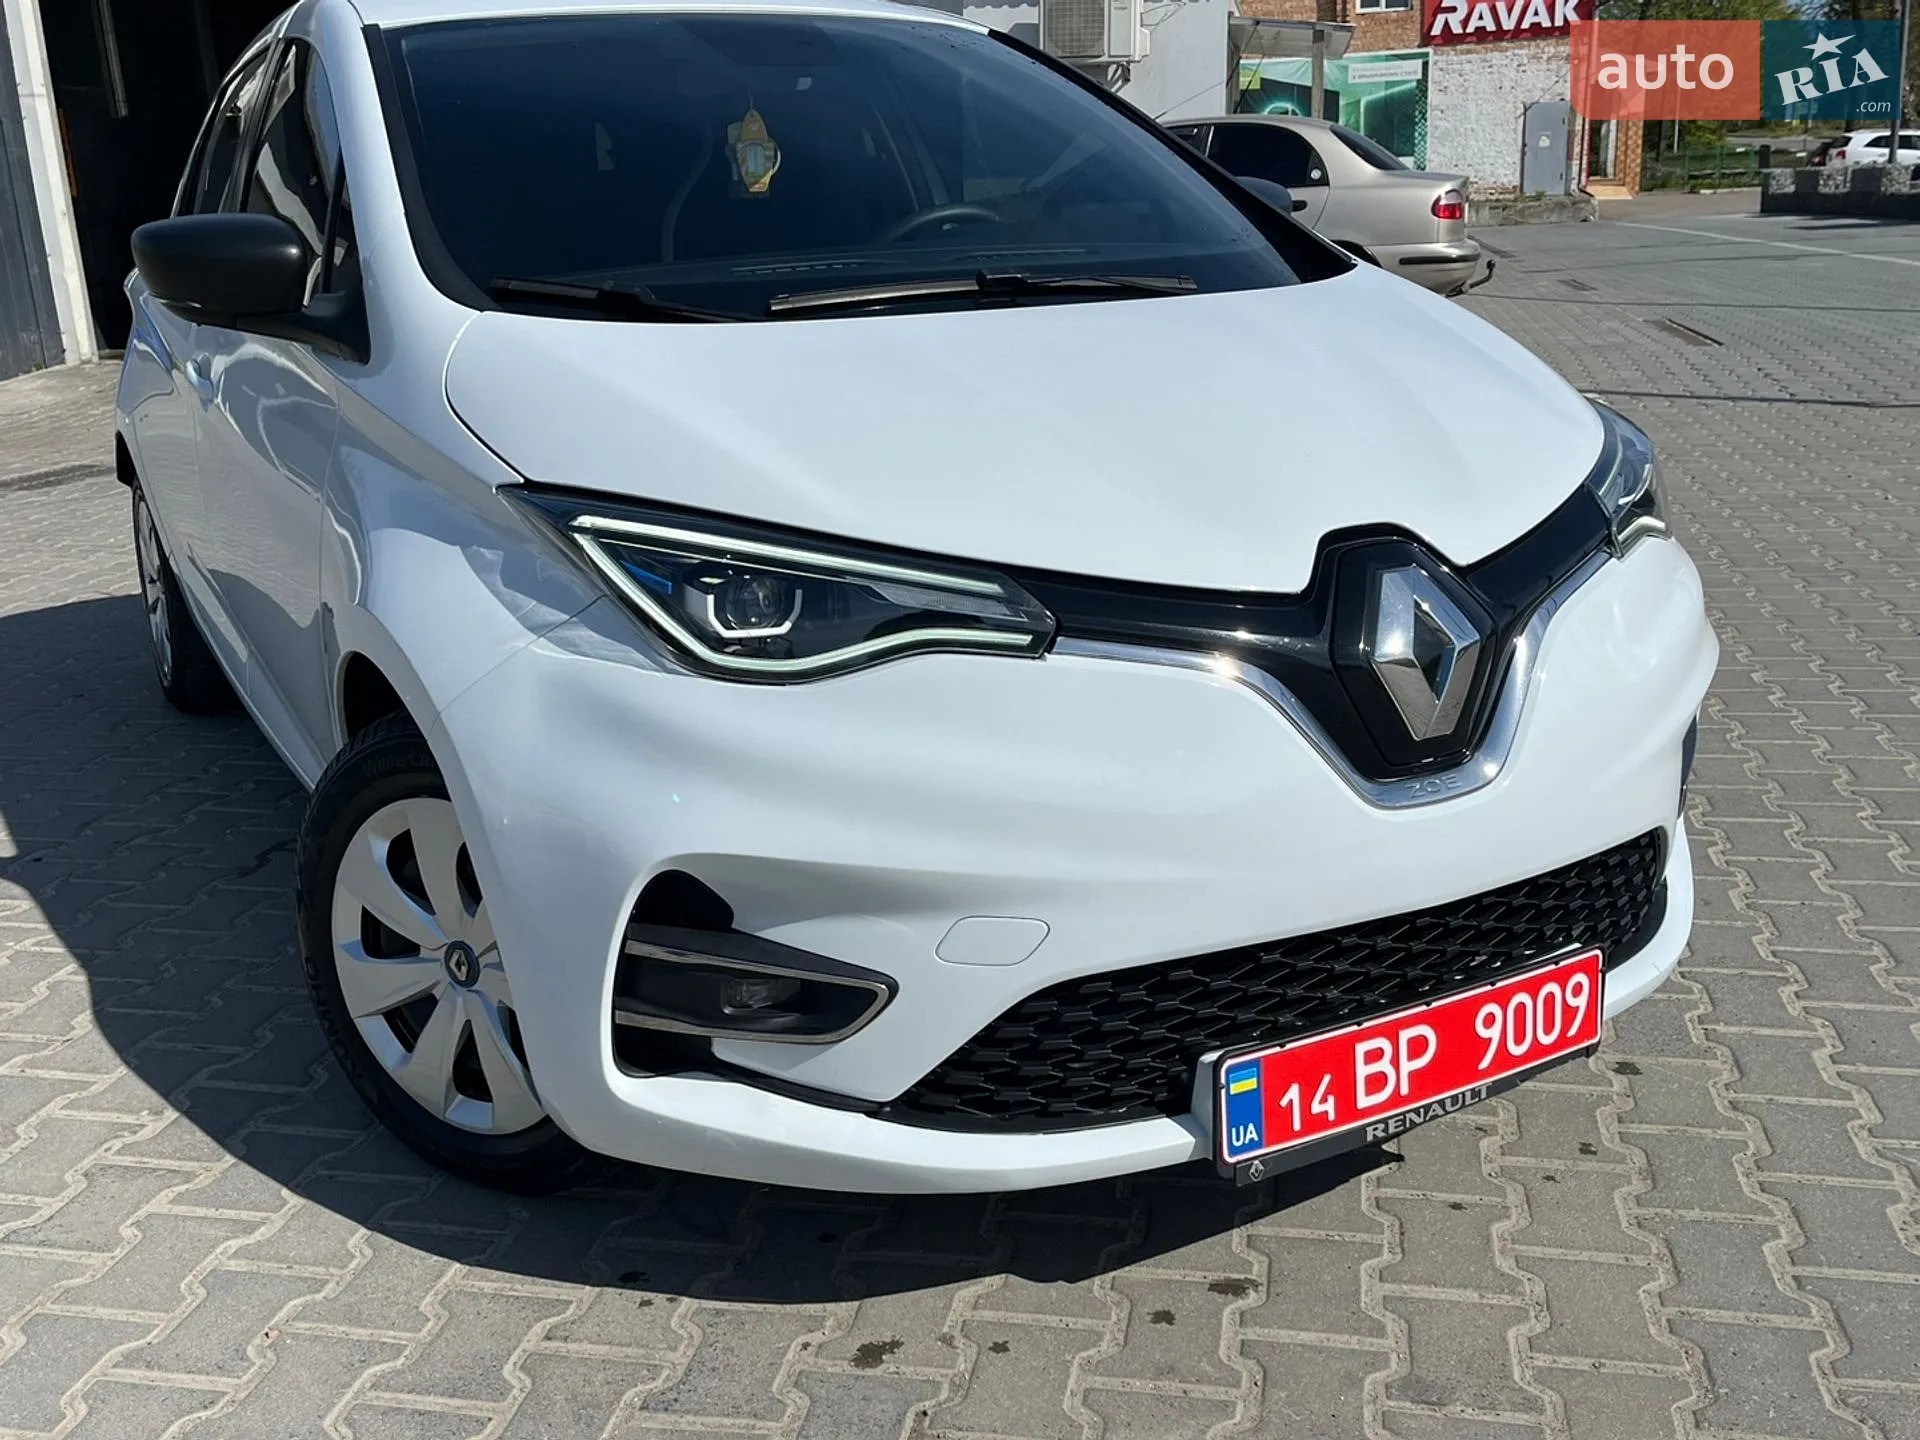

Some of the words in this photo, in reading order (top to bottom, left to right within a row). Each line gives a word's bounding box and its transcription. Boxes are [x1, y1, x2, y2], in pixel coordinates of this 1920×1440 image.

[1430, 0, 1582, 36] RAVAK
[1405, 774, 1463, 799] ZOE
[1279, 1073, 1336, 1132] 14
[1354, 1023, 1437, 1111] BP
[1474, 972, 1590, 1071] 9009
[1364, 1082, 1493, 1143] RENAULT
[1231, 1127, 1259, 1148] UA
